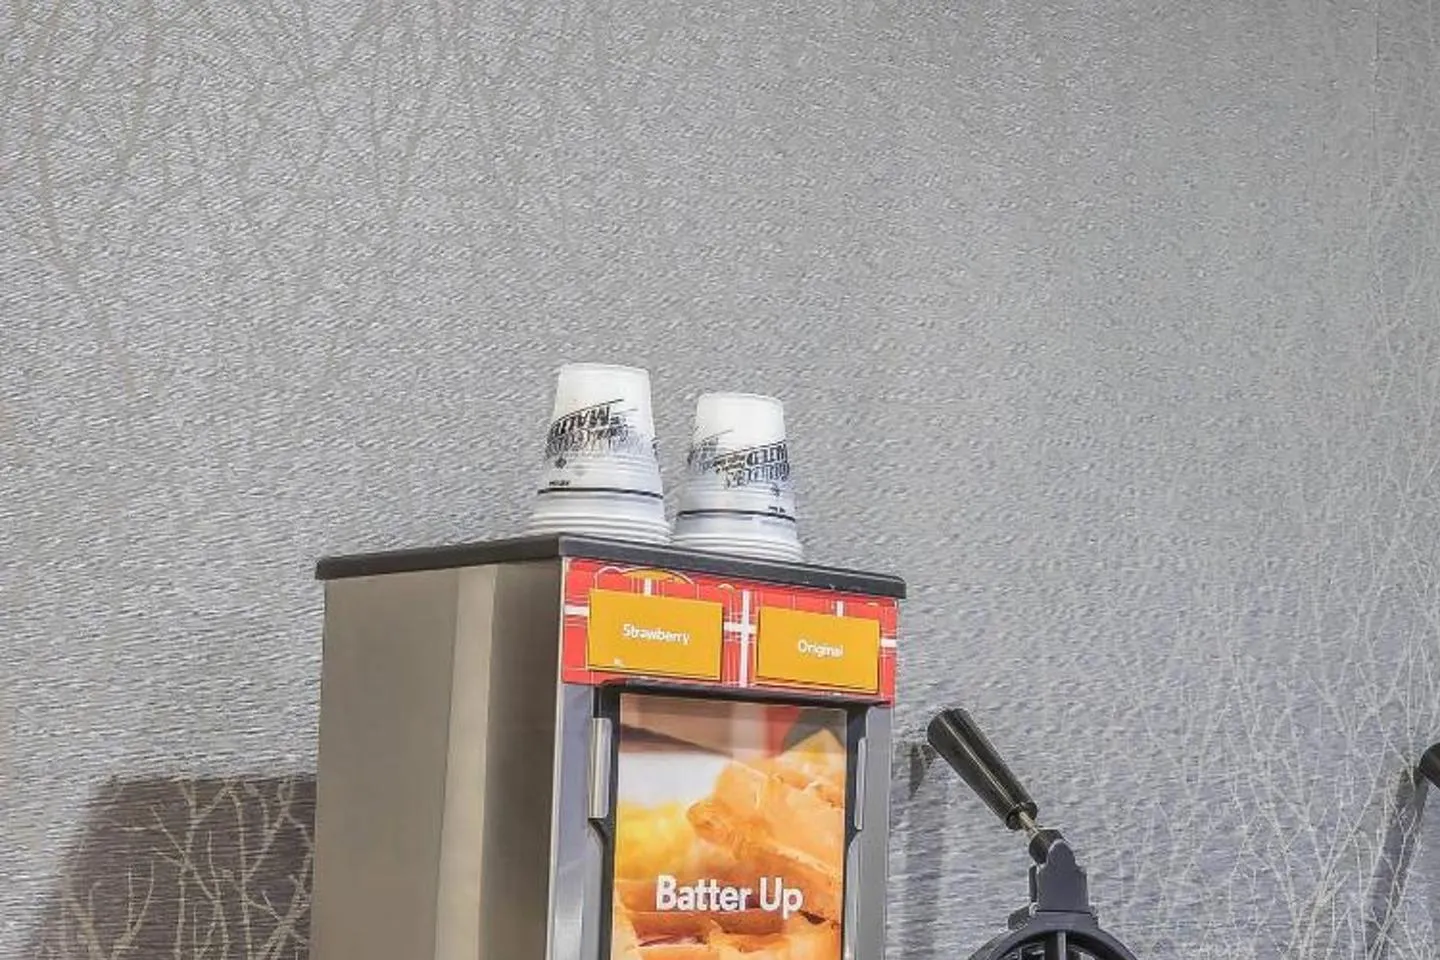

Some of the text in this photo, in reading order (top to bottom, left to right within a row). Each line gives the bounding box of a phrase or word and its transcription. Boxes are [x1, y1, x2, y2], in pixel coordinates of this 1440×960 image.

[622, 623, 691, 646] Strawberry
[797, 639, 845, 658] Original
[655, 873, 804, 919] Batter Up
